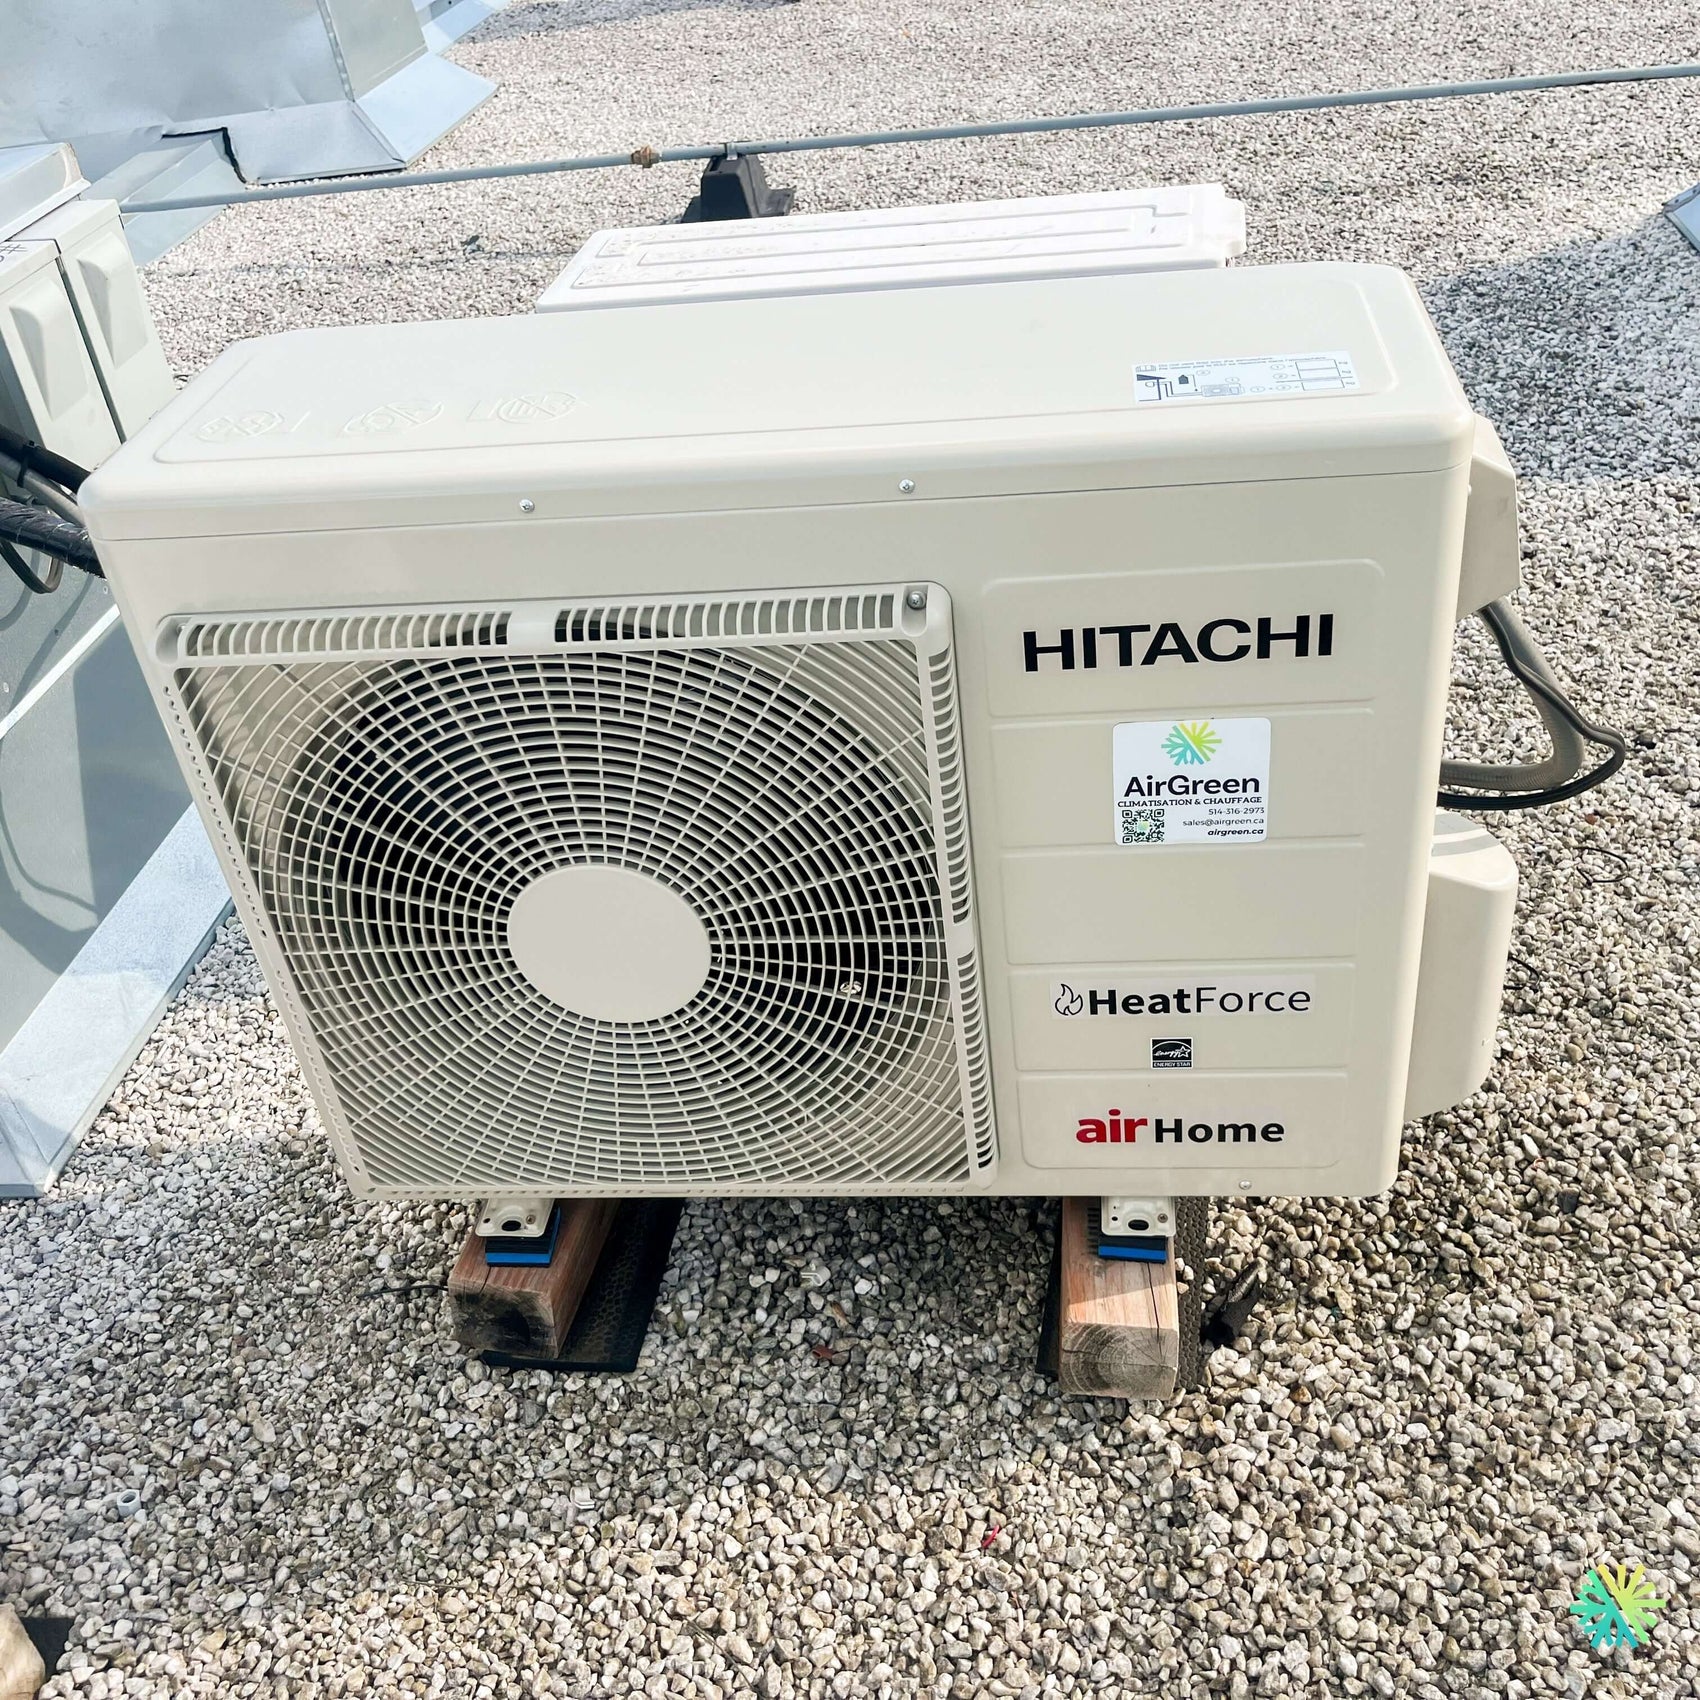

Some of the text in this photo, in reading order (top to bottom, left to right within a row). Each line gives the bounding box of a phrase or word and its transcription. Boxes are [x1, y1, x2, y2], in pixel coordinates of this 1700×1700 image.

[1023, 613, 1334, 672] HITACHI
[1124, 775, 1260, 797] AirGreen
[1117, 799, 1192, 808] CLIMATISATION
[1203, 796, 1262, 805] CHAUFFAGE
[1208, 807, 1265, 815] 514-316-2973
[1182, 818, 1264, 827] sales@airgreen.ca
[1207, 828, 1264, 837] airgreen.ca
[1089, 986, 1311, 1015] HeatForce
[1076, 1108, 1285, 1143] air Home
